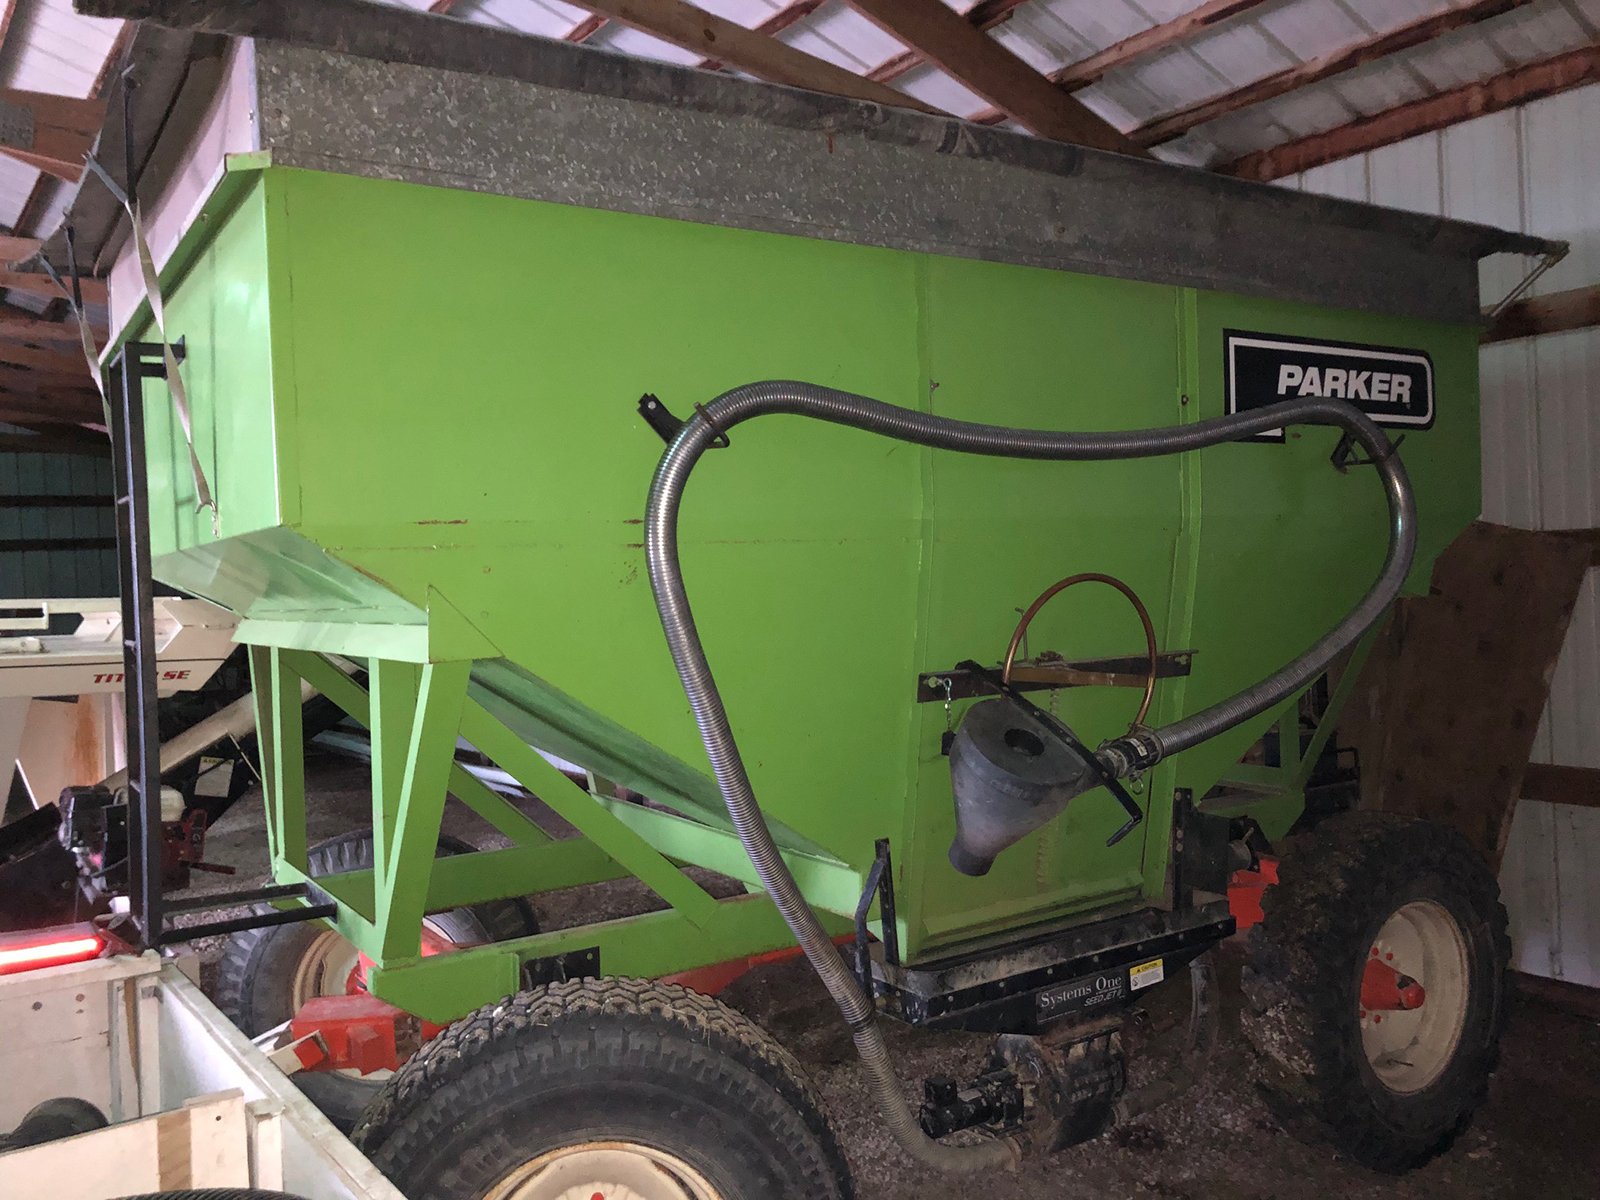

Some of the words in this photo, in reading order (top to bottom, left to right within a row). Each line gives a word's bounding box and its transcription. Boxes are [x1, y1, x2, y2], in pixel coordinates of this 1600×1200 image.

[1277, 364, 1412, 403] PARKER
[162, 670, 192, 681] SE
[1040, 984, 1092, 1009] Systems
[1095, 976, 1122, 991] One
[1084, 994, 1104, 1007] SEED
[1103, 990, 1117, 1001] JET
